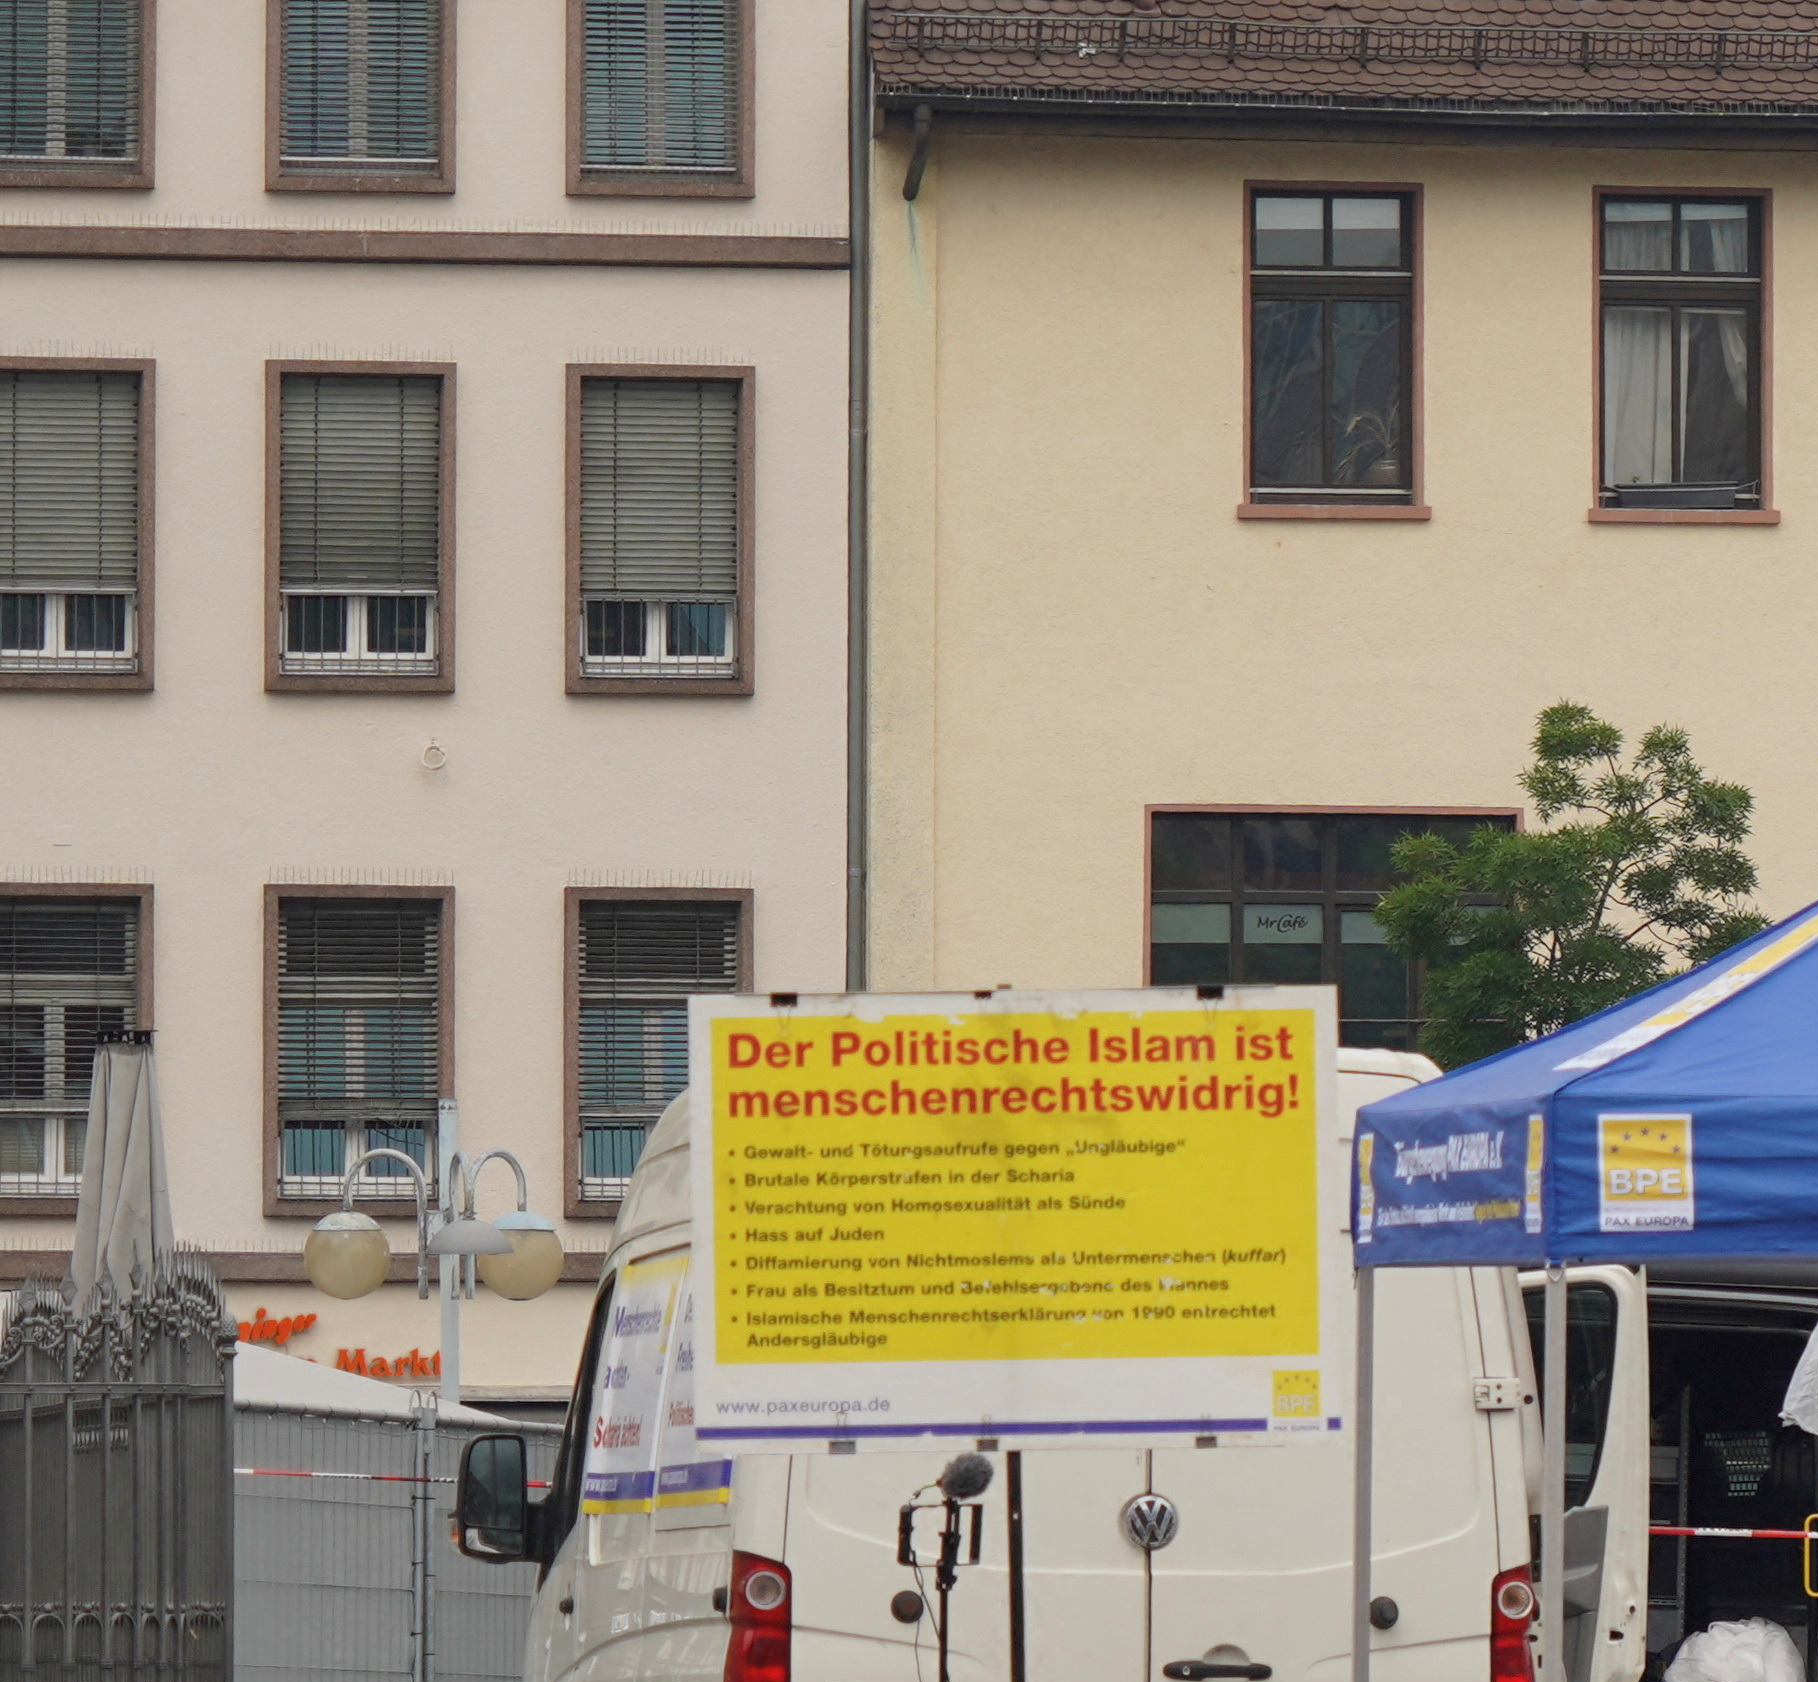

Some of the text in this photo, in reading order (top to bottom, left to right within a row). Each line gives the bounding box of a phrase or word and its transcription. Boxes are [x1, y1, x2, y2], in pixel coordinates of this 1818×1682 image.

[728, 1025, 1293, 1069] Der Politische Islam ist
[728, 1073, 1299, 1119] menschenrechtswidrig!
[744, 1143, 814, 1160] Gewalt-
[820, 1143, 853, 1158] und
[860, 1141, 999, 1160] Tötungsaufrufe
[1005, 1143, 1059, 1158] gegen
[744, 1168, 1075, 1188] Brutale Körperstrafen in der Scharia
[1610, 1168, 1683, 1195] BPE
[745, 1195, 1126, 1216] Verachtung von Homosexualität als Sünde
[1605, 1216, 1689, 1226] PAX EUROPA
[745, 1227, 884, 1243] Hass auf Juden
[746, 1248, 1286, 1271] Diffamierung von Nichtmoslems als Untermenschen (kuffar)
[747, 1283, 785, 1298] Frau
[792, 1283, 817, 1297] als
[824, 1281, 914, 1297] Besitztum
[921, 1280, 954, 1295] und
[1121, 1278, 1151, 1292] des
[747, 1304, 1276, 1327] Islamische Menschenrechtserklärung von 1990 entrechtet
[747, 1332, 888, 1349] Andersgläubige
[716, 1397, 890, 1416] www.paxeuropa.de
[1275, 1395, 1318, 1415] BPE
